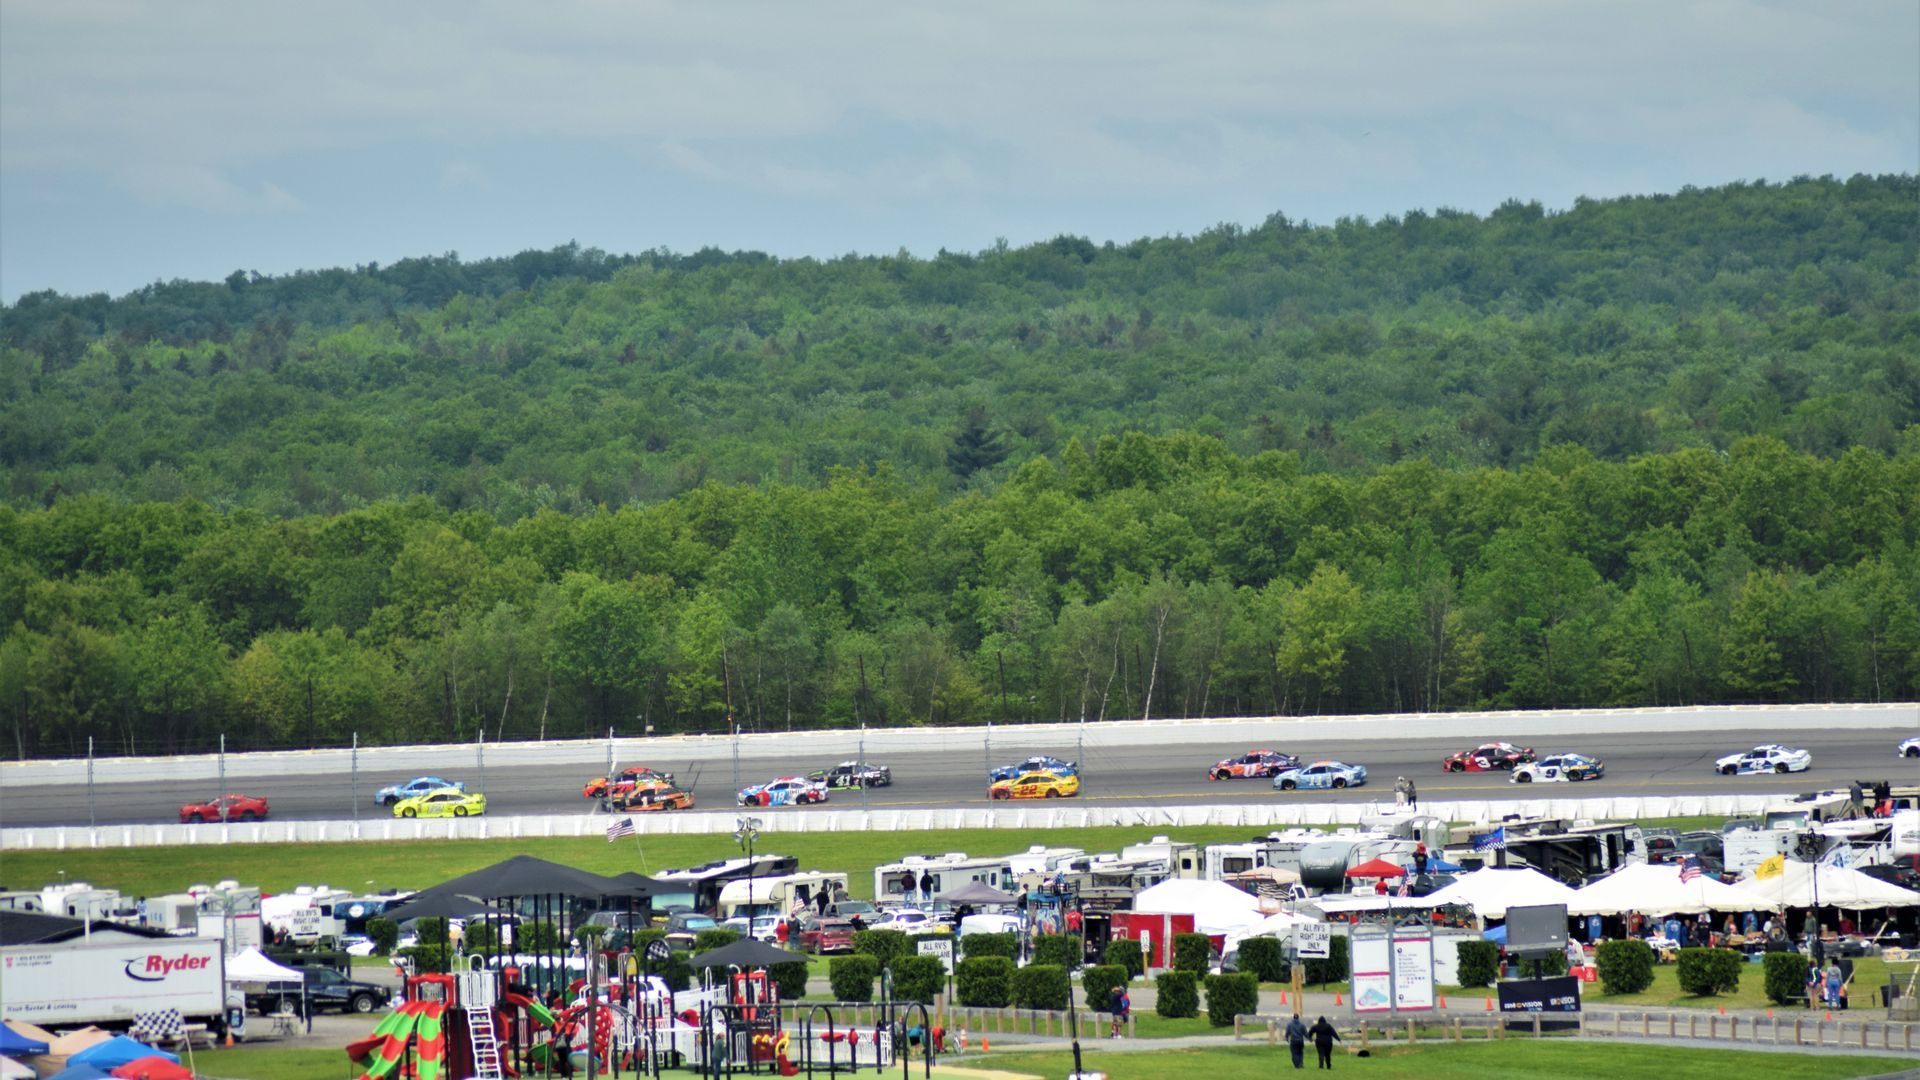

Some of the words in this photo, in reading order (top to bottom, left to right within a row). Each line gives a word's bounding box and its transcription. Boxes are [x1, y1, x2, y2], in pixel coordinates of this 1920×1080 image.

[1475, 756, 1491, 769] 3
[1749, 759, 1766, 770] 42
[1545, 768, 1557, 779] 9
[835, 775, 851, 786] 41
[1020, 785, 1038, 795] 22
[641, 796, 649, 807] 1
[773, 791, 786, 802] 18
[1303, 923, 1312, 932] ALL
[1315, 933, 1328, 941] LANE
[923, 943, 932, 951] ALL
[1307, 942, 1320, 950] ONLY
[145, 953, 211, 976] Ryder
